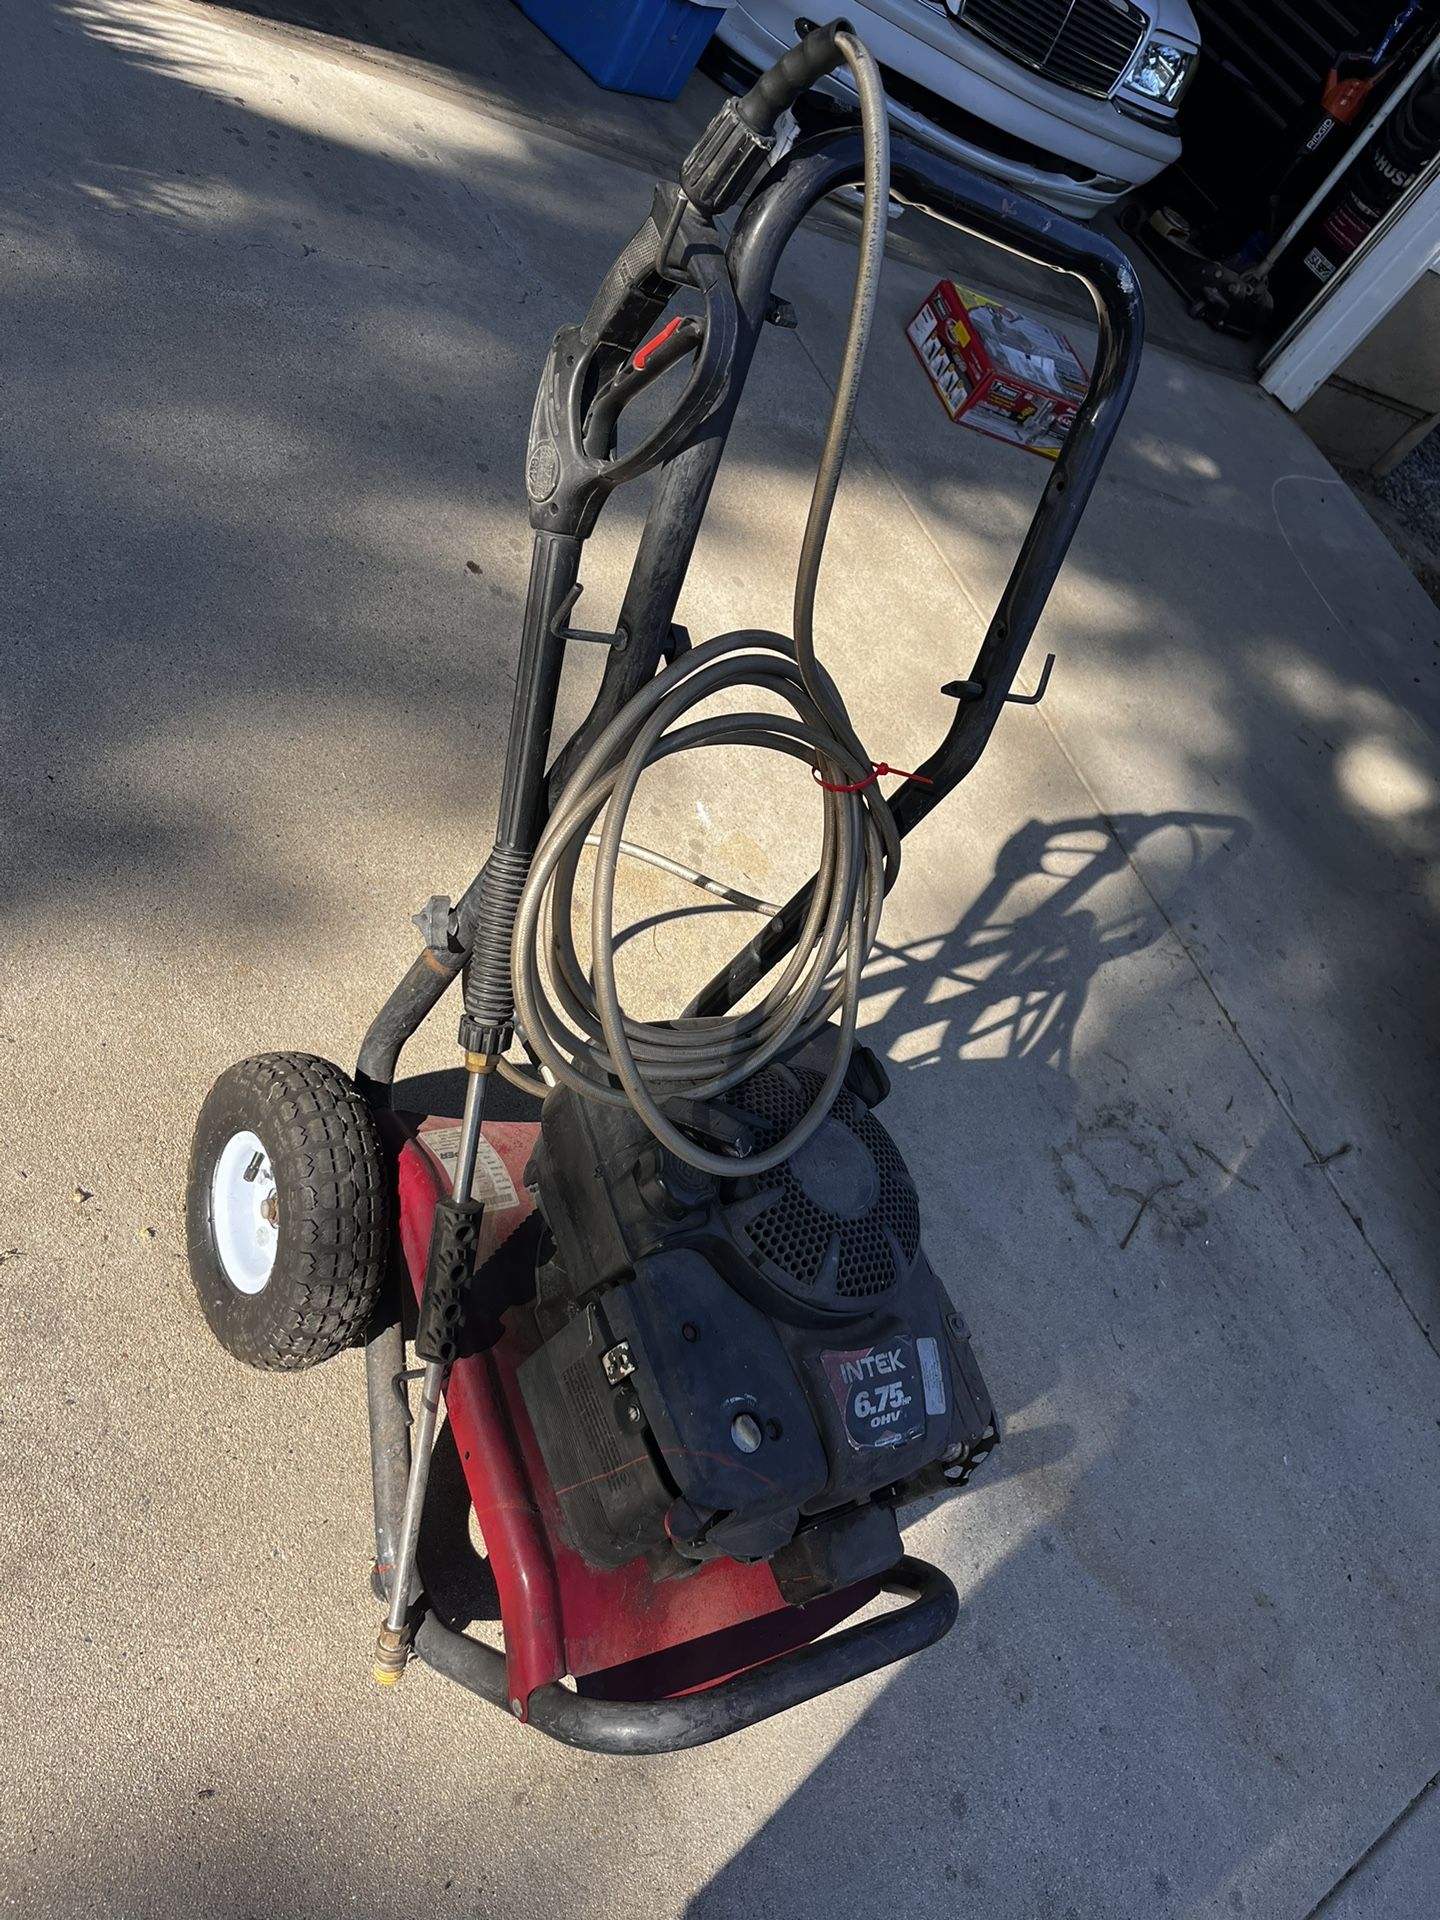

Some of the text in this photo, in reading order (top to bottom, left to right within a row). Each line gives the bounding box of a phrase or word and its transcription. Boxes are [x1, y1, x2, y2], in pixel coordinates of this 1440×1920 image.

[1306, 118, 1333, 150] RIDGID
[840, 1348, 906, 1384] INTEK
[855, 1381, 904, 1418] 6.75
[870, 1410, 901, 1428] OHV
